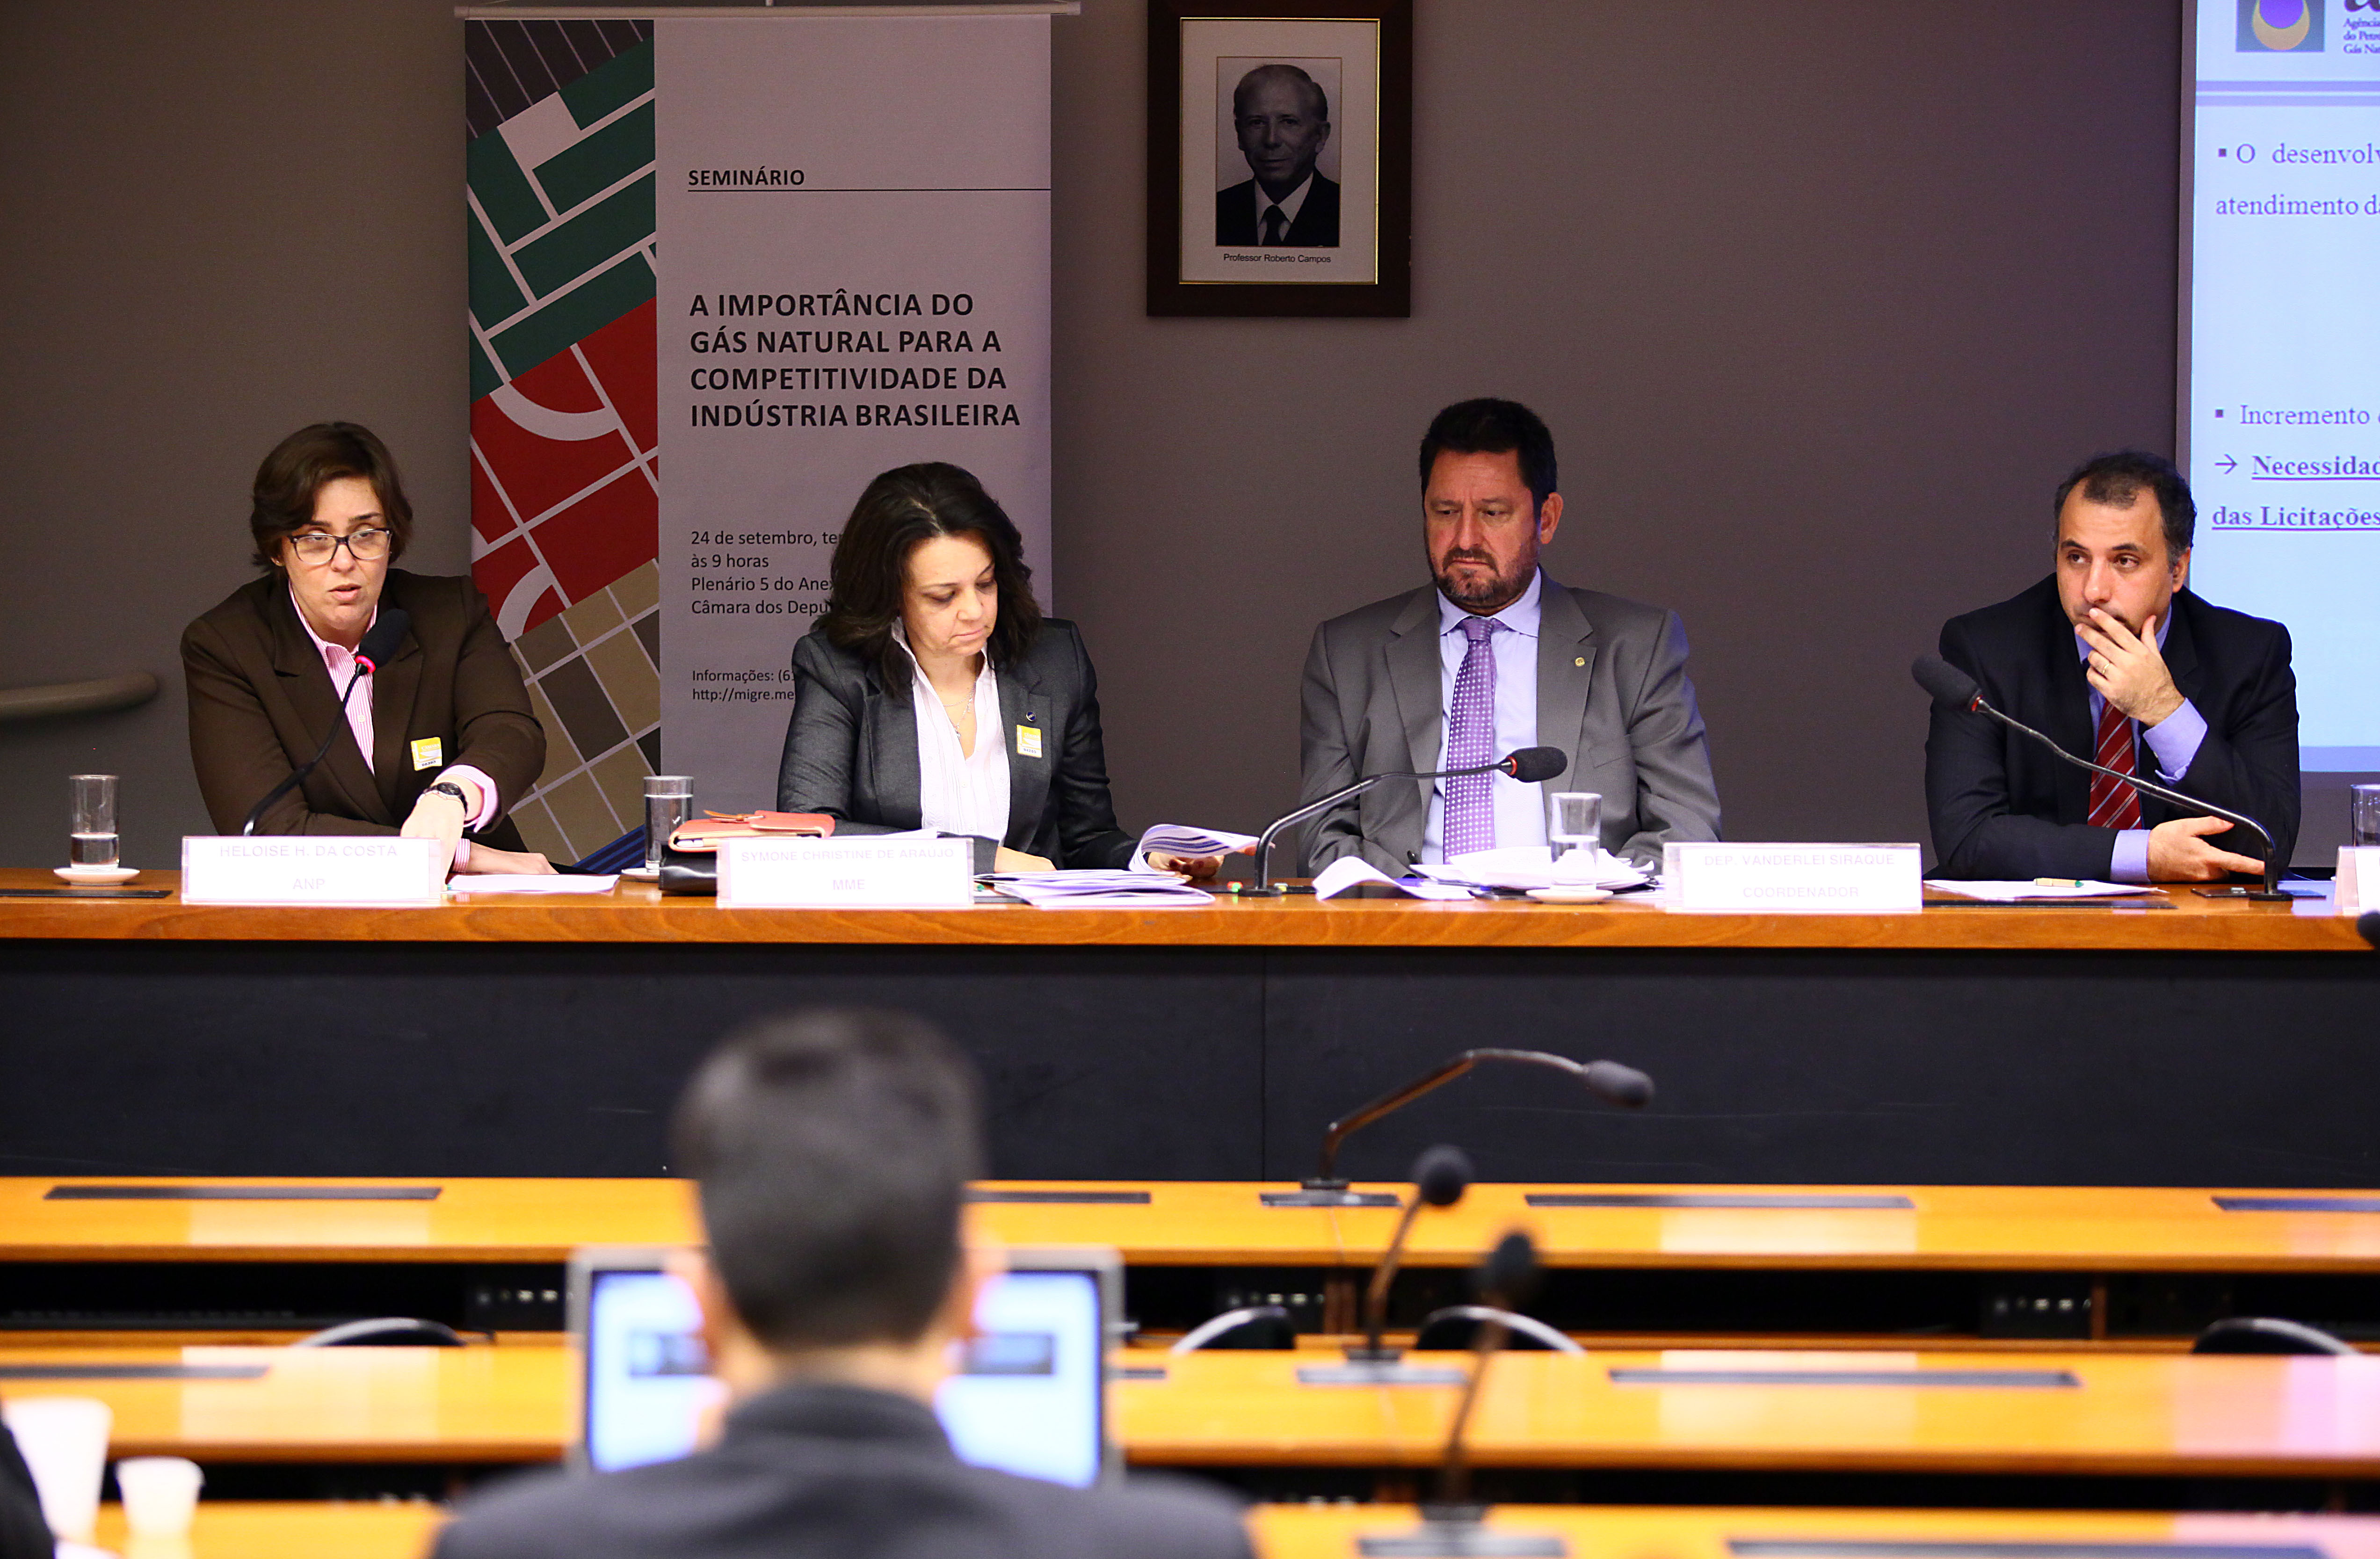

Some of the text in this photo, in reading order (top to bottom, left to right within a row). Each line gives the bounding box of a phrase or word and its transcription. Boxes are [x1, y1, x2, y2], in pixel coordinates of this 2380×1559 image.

[2236, 144, 2256, 164] O
[689, 166, 805, 186] SEMINÁRIO
[2216, 194, 2380, 215] atendimento d
[1223, 253, 1331, 264] Professor Roberto Campos
[689, 288, 973, 316] A IMPORTÂNCIA DO
[690, 325, 1001, 353] GÁS NATURAL PARA A
[691, 367, 1007, 390] COMPETITIVIDADE DA
[692, 399, 1020, 427] INDÚSTRIA BRASILEIRA
[2240, 405, 2370, 425] Incremento
[2212, 506, 2380, 528] das Licitações
[691, 531, 710, 544] 24
[715, 530, 734, 545] de
[739, 530, 817, 547] setembro,
[691, 553, 769, 568] às 9 horas
[692, 576, 755, 591] Plenário
[760, 577, 769, 591] 5
[774, 576, 794, 591] do
[691, 599, 750, 614] Câmara
[755, 600, 783, 614] dos
[692, 669, 774, 684] Informações:
[220, 845, 398, 857] HELOISE H. DA COSTA
[741, 851, 798, 862] SYMONE
[803, 850, 873, 861] CHRISTINE
[878, 849, 894, 859] DE
[1704, 854, 1894, 866] DEP. VANDERLEI SIRAQUE
[293, 878, 325, 890] ANP
[832, 879, 865, 890] MME
[1743, 886, 1859, 898] COORDENADOR
